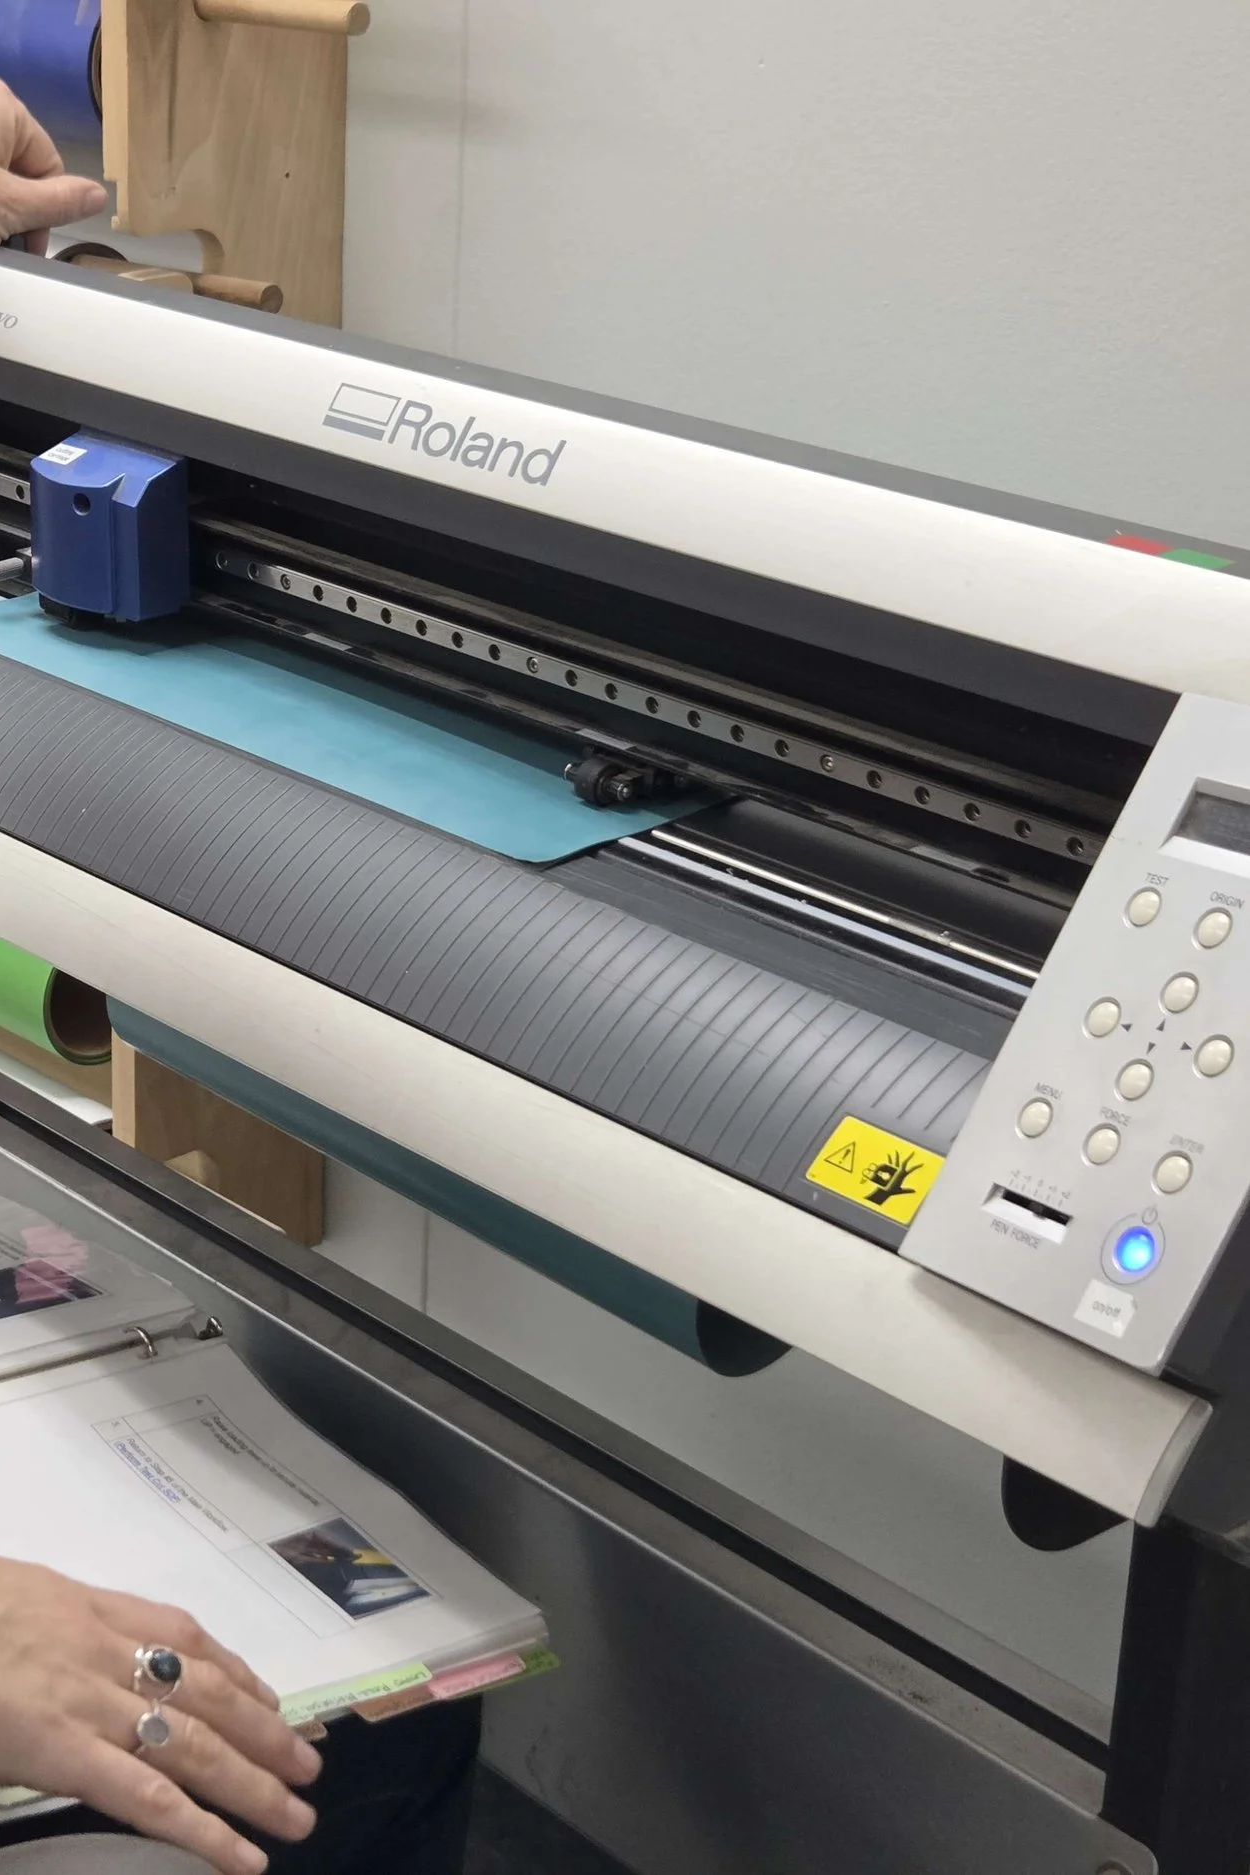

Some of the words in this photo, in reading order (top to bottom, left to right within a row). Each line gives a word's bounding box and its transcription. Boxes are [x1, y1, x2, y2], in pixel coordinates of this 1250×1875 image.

[388, 400, 567, 486] Roland
[1145, 872, 1169, 886] TEST
[1210, 891, 1244, 908] ORIGIN
[1034, 1082, 1063, 1100] MENU
[1100, 1106, 1132, 1127] FORCE
[990, 1219, 1009, 1235] PEN
[1011, 1227, 1040, 1249] FORCE
